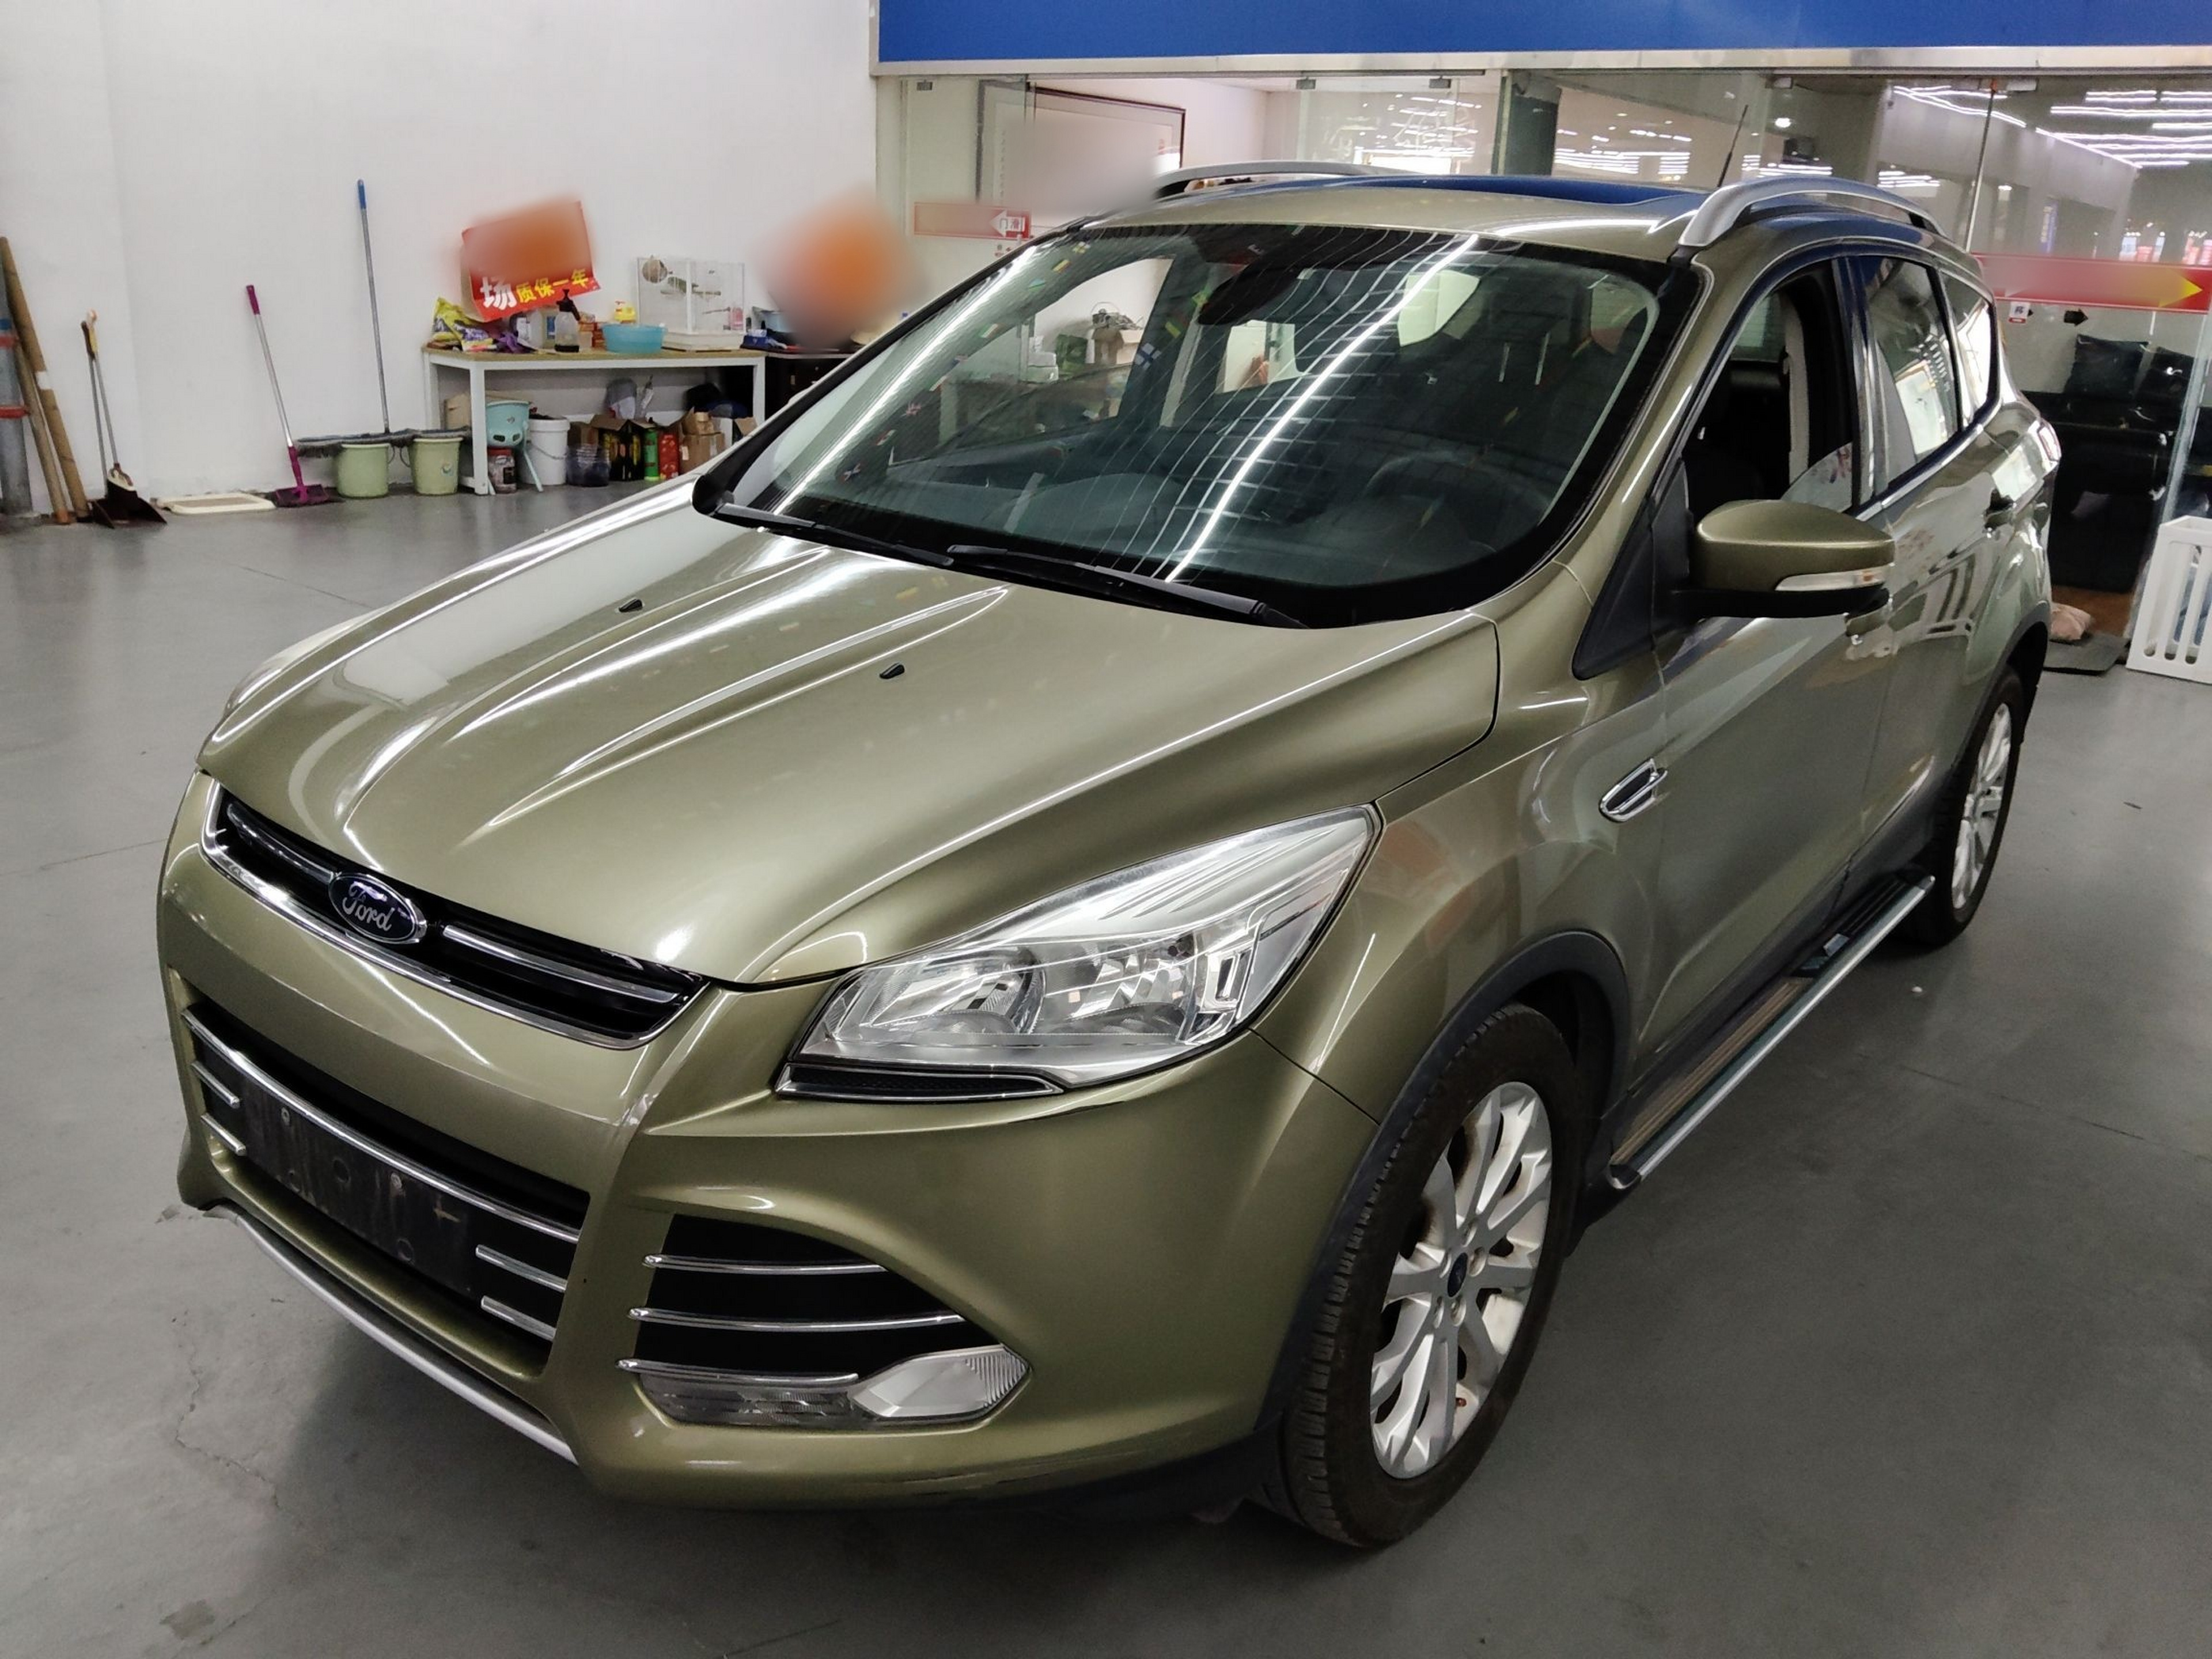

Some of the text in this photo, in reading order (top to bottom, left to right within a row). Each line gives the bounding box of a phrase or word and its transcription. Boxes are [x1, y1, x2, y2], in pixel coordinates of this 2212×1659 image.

[516, 268, 589, 303] 质保一年
[342, 881, 395, 931] Ford
